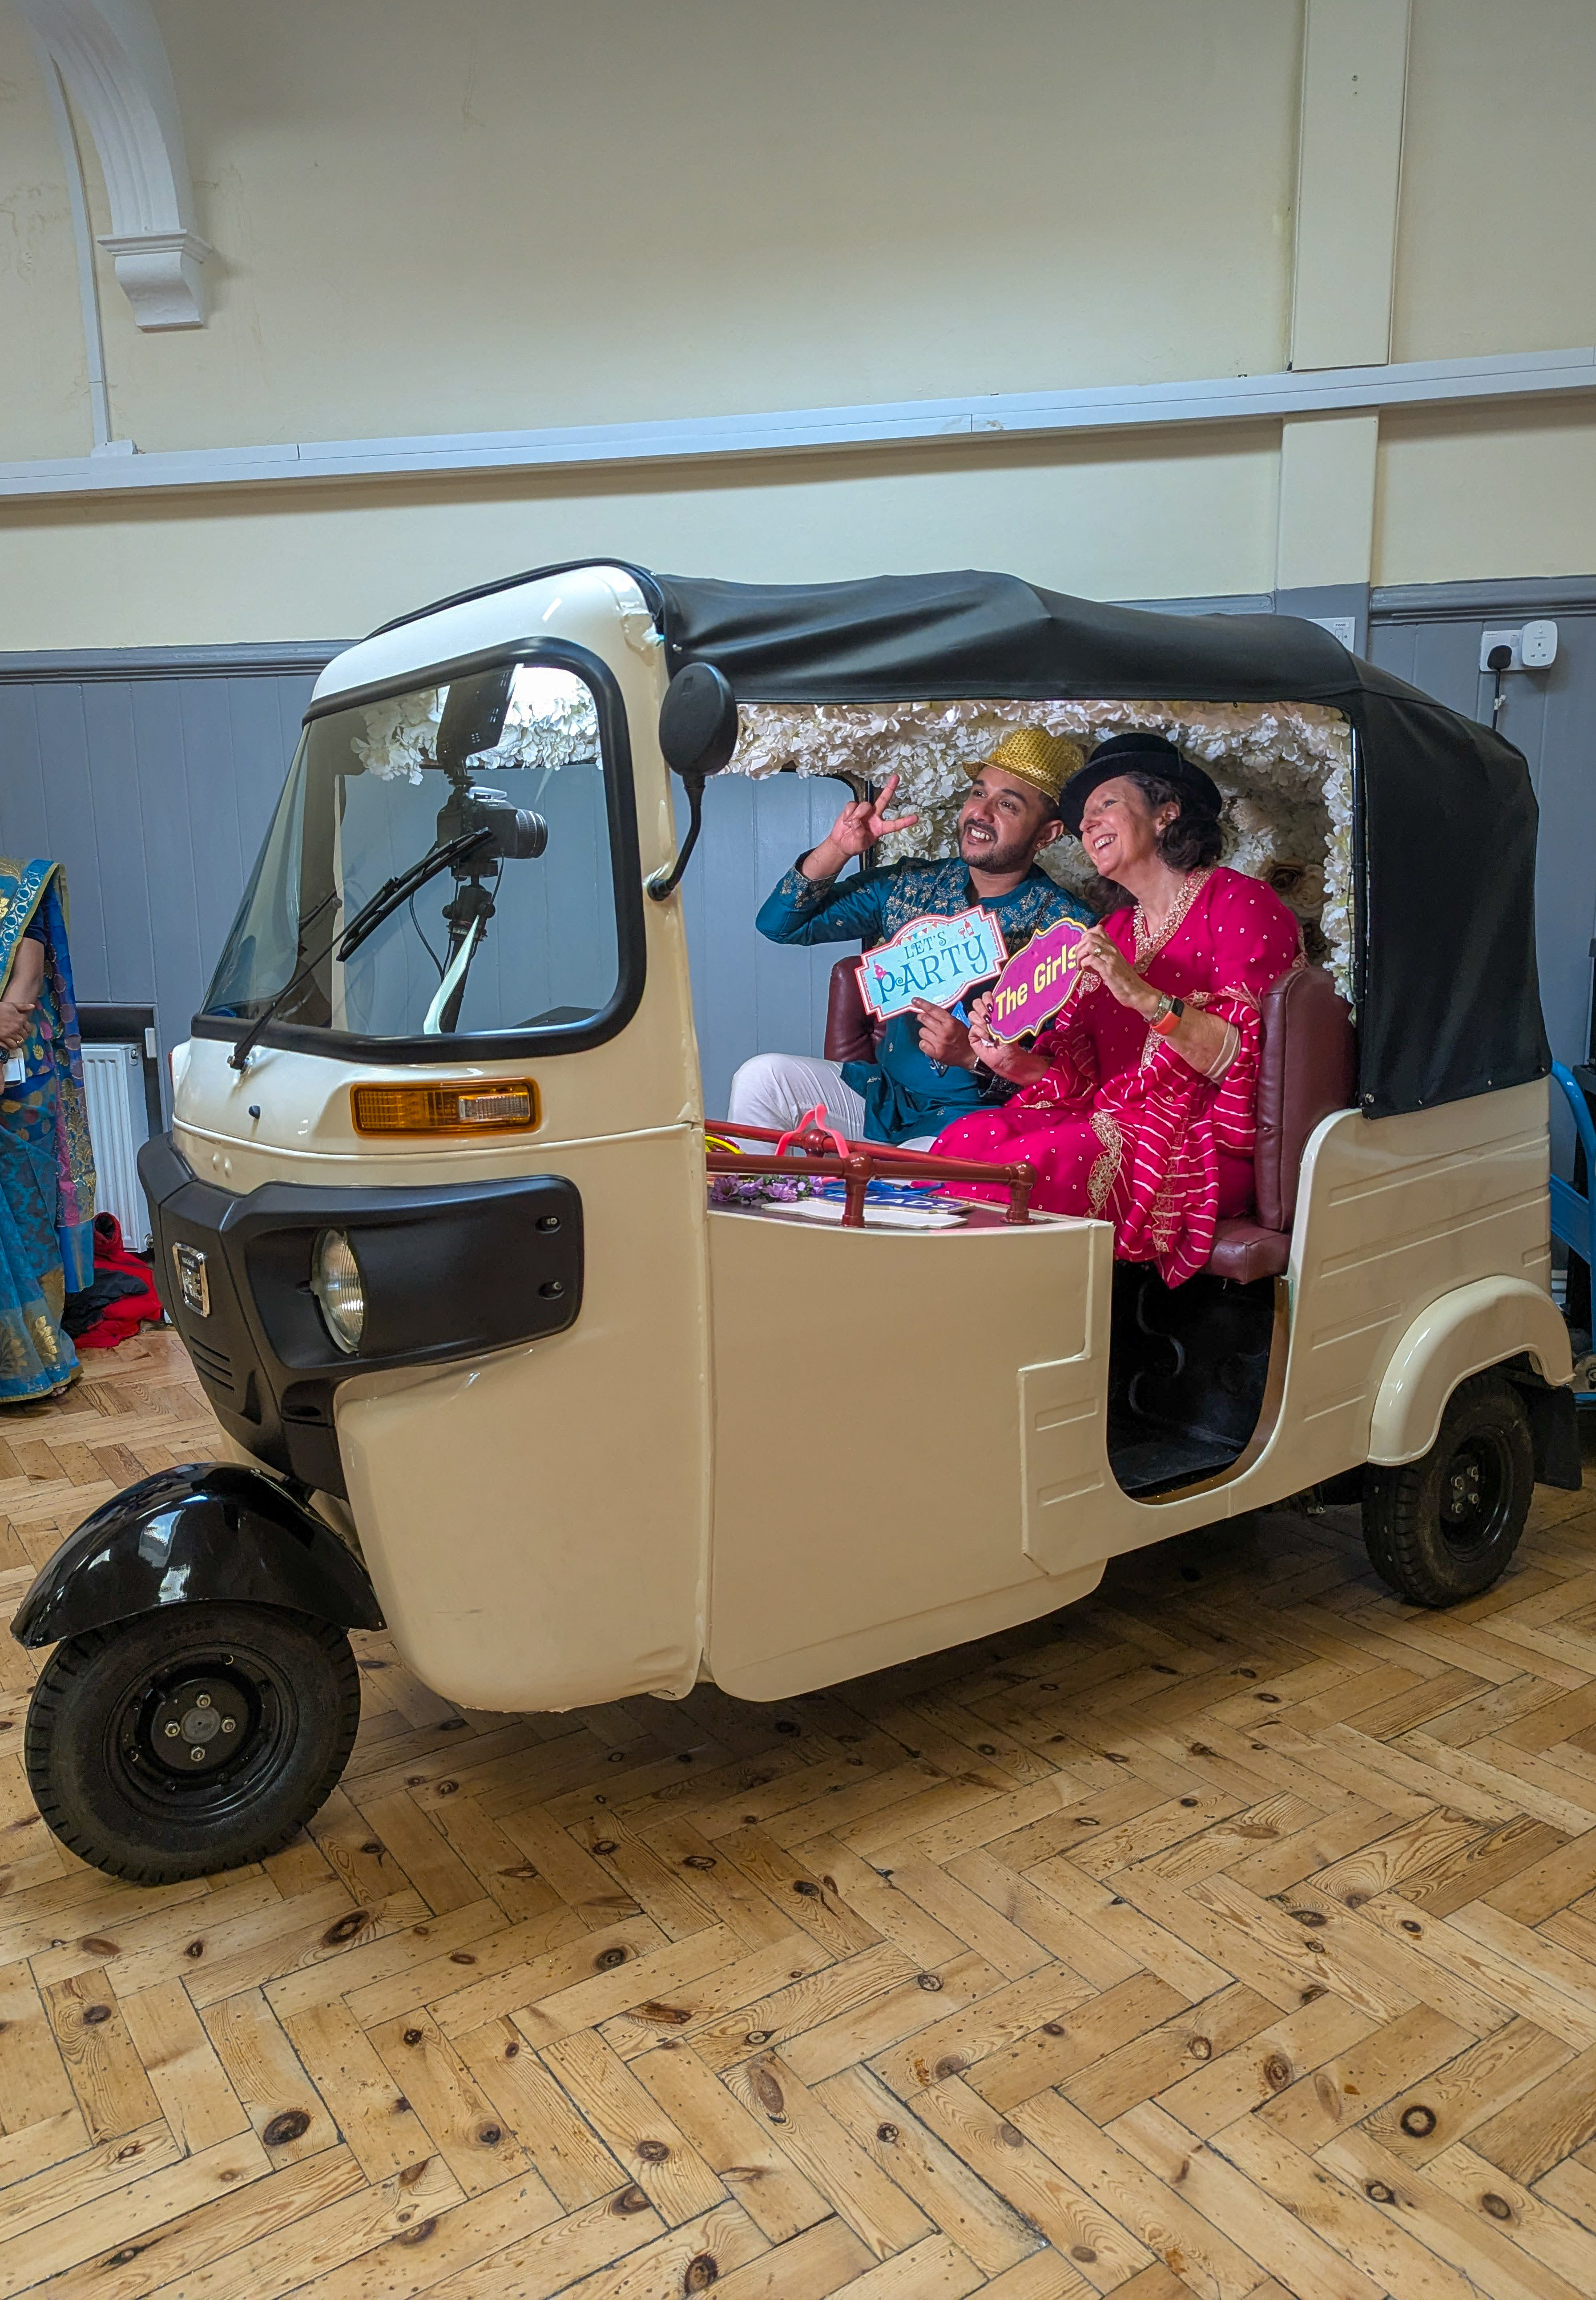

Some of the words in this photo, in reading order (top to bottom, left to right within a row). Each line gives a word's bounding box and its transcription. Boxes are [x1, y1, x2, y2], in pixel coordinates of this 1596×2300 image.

[904, 931, 947, 960] LET'S
[996, 982, 1028, 1021] The
[1034, 944, 1077, 993] Girls
